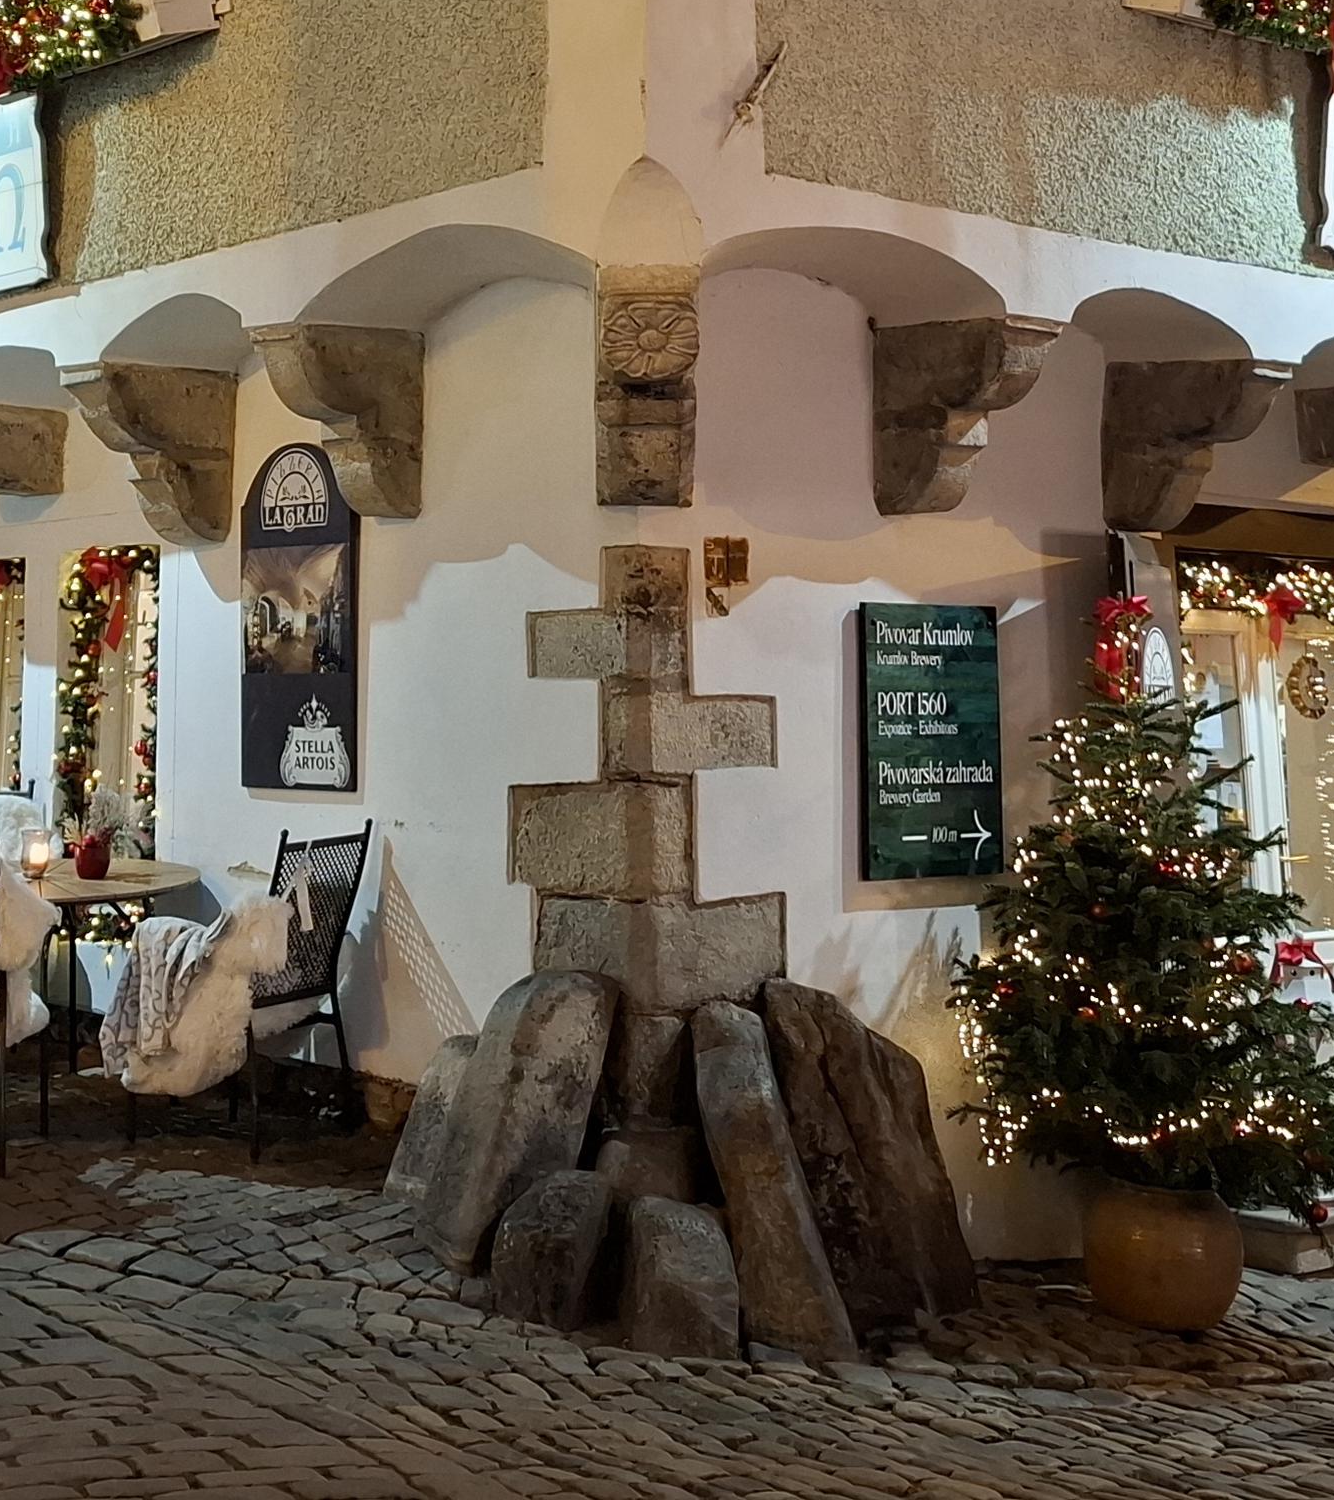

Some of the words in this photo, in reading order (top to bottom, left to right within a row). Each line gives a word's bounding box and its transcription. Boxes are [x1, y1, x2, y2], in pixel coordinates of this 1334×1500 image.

[875, 620, 922, 646] Pivovar
[922, 621, 975, 647] Krumlov
[876, 648, 910, 666] Krumlov
[910, 650, 944, 670] Brewery
[877, 691, 916, 717] PORT
[917, 691, 948, 717] 1560
[878, 719, 913, 739] Expozice
[294, 739, 336, 754] STELLA
[294, 755, 336, 771] ARTOIS
[878, 759, 945, 787] Pivovarská
[945, 759, 995, 785] zahrada
[879, 788, 912, 808] Brewery
[912, 787, 942, 805] Garden
[931, 825, 948, 844] 100
[948, 829, 958, 843] m
